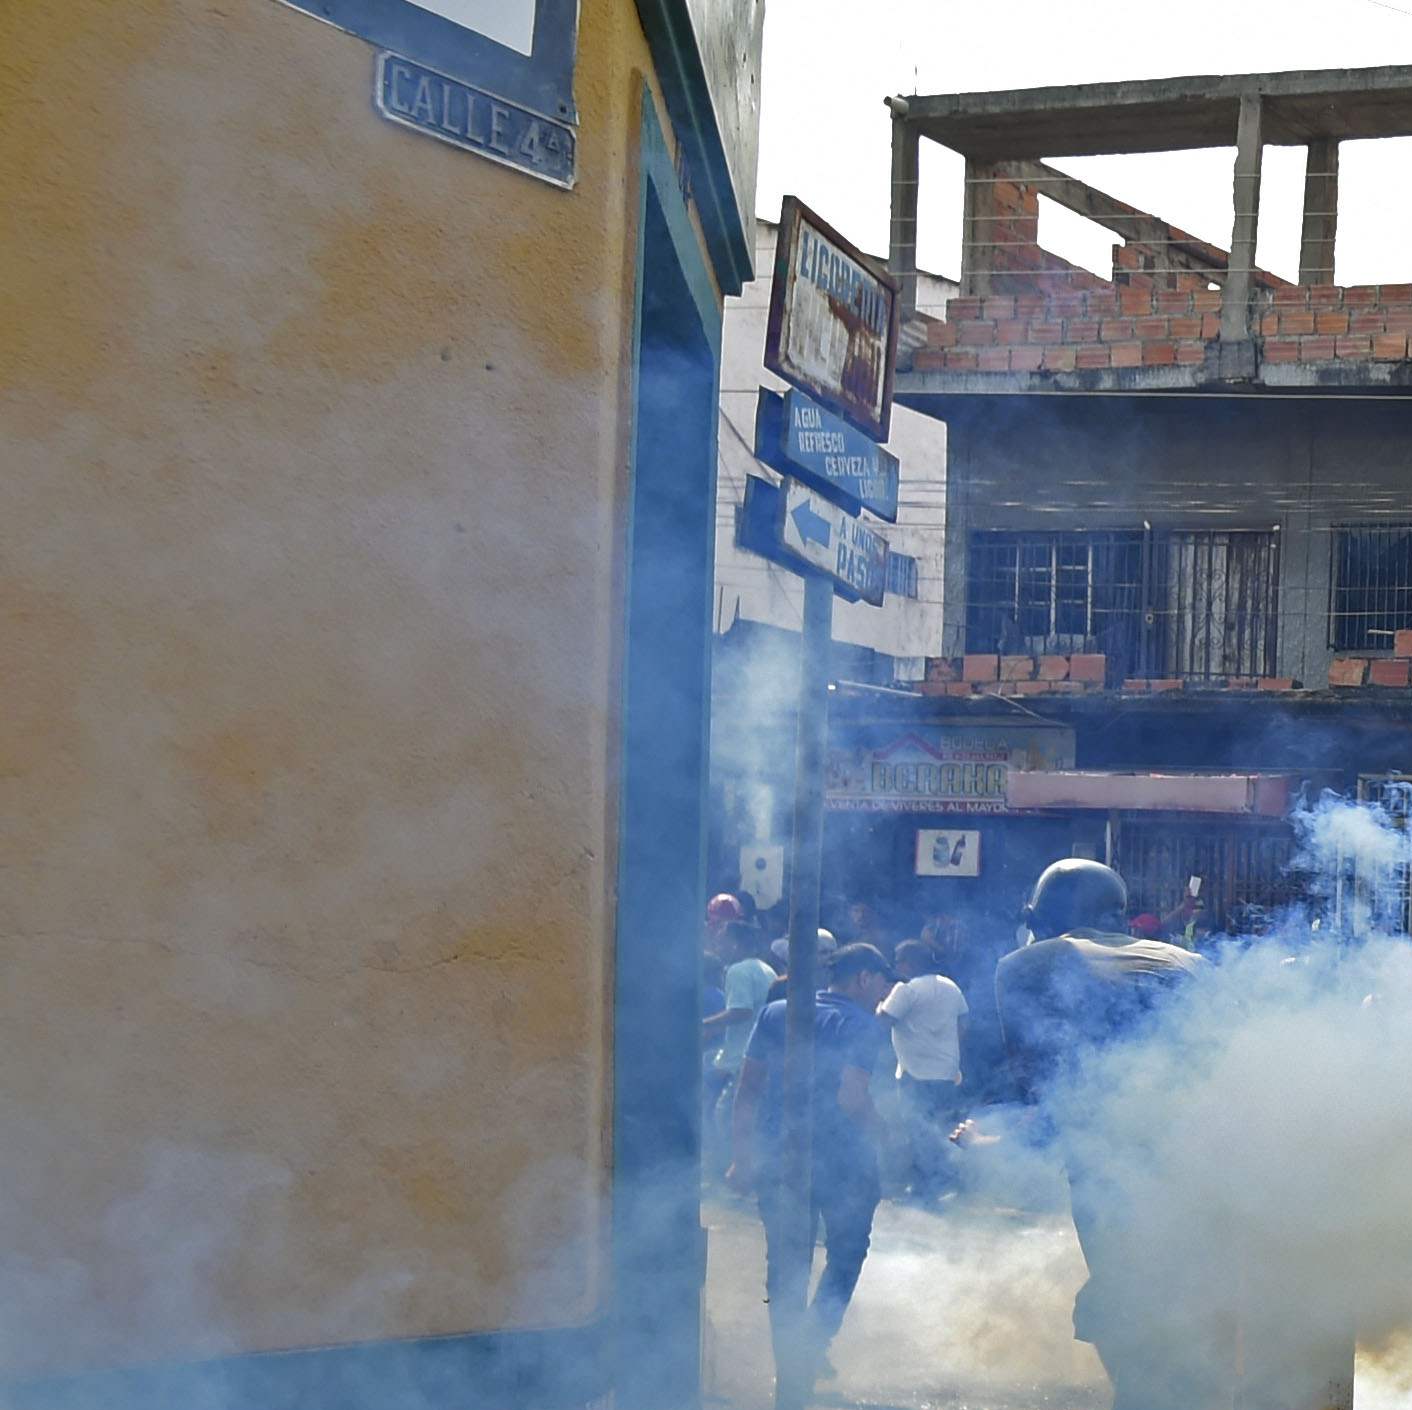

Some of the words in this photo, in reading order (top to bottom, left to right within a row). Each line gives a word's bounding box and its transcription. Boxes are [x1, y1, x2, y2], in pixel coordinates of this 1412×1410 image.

[391, 63, 511, 156] CALLE
[794, 407, 822, 429] AGUA
[799, 431, 845, 454] REFRESCO
[825, 456, 870, 477] CERVEZA
[892, 801, 944, 812] VIVERES
[946, 802, 964, 812] AL
